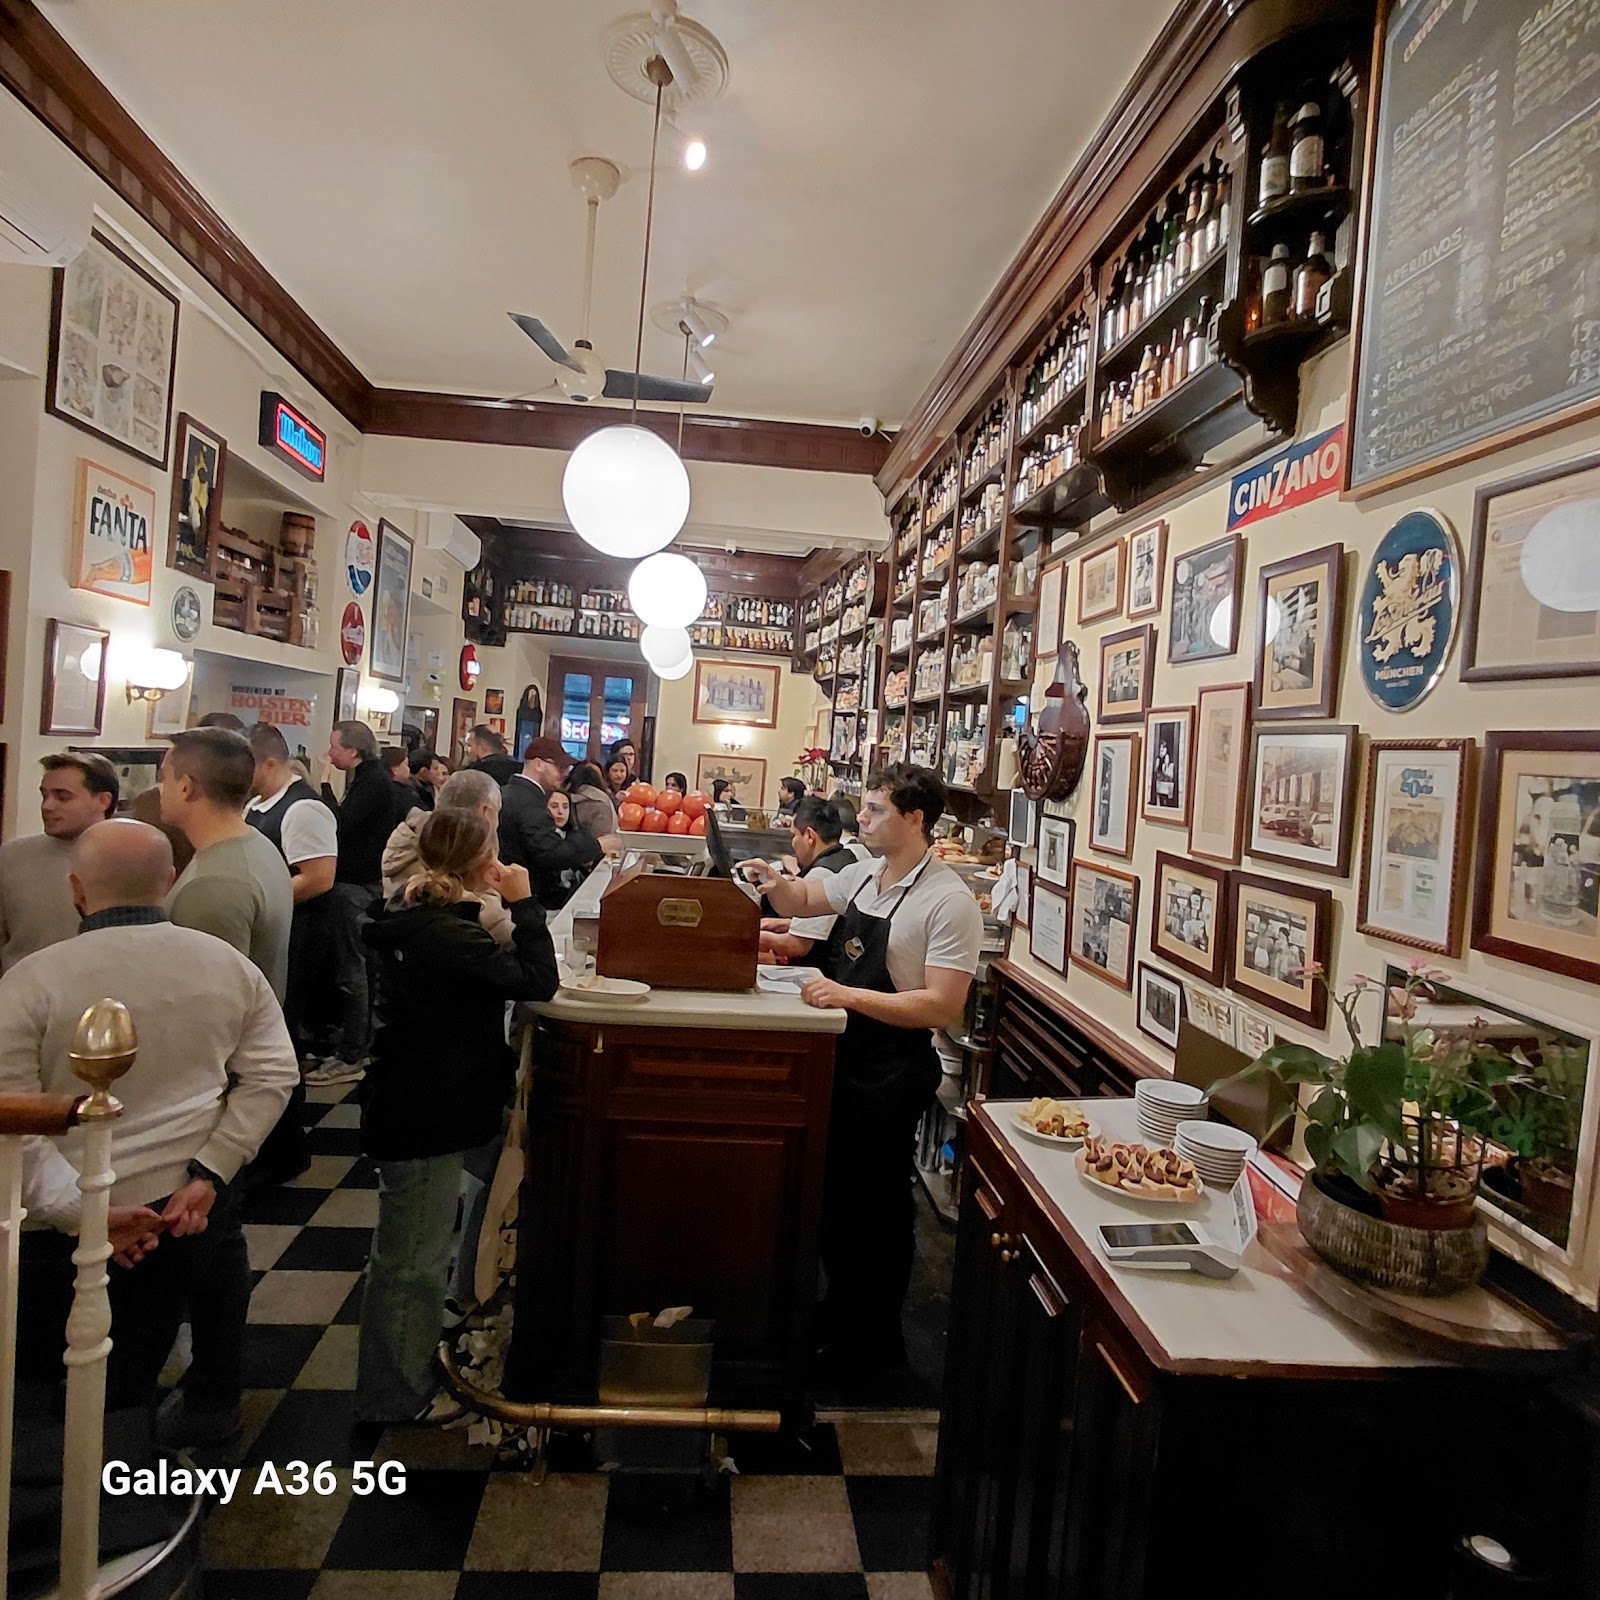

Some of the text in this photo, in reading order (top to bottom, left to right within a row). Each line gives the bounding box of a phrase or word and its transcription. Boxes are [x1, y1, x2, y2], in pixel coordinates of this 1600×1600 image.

[1384, 226, 1468, 291] APERITIVOS:
[280, 411, 321, 469] Mahou
[1234, 442, 1341, 515] CINZANO
[90, 496, 147, 554] FANTA
[1375, 664, 1425, 680] MÜNCHEN
[231, 694, 311, 713] HOLSTEN
[259, 710, 311, 727] BIER
